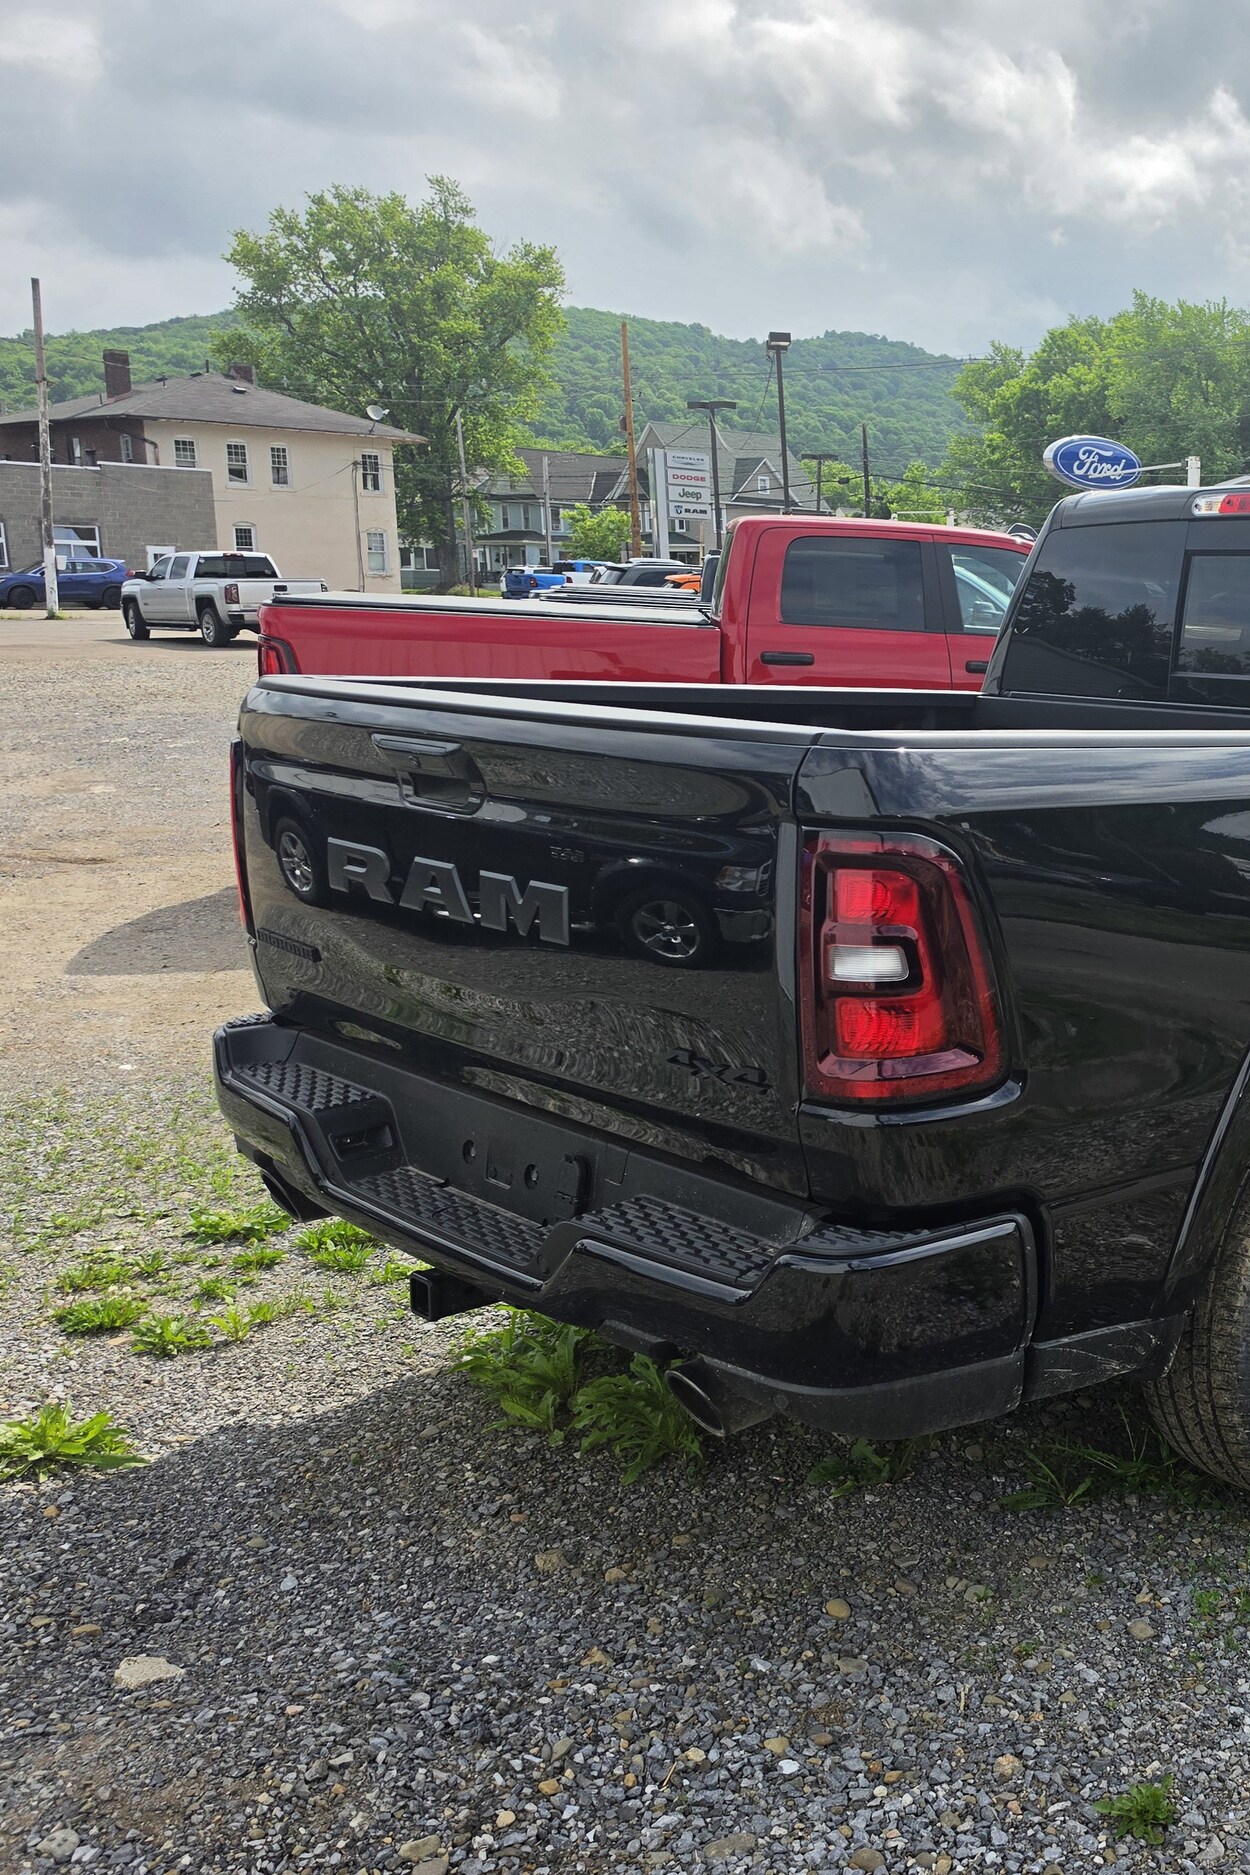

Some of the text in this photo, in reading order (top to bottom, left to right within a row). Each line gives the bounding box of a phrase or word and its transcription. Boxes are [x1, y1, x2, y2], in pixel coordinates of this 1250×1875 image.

[1073, 446, 1126, 480] Ford
[672, 474, 706, 482] DODGE
[678, 488, 702, 501] Jeep
[327, 836, 570, 946] RAM
